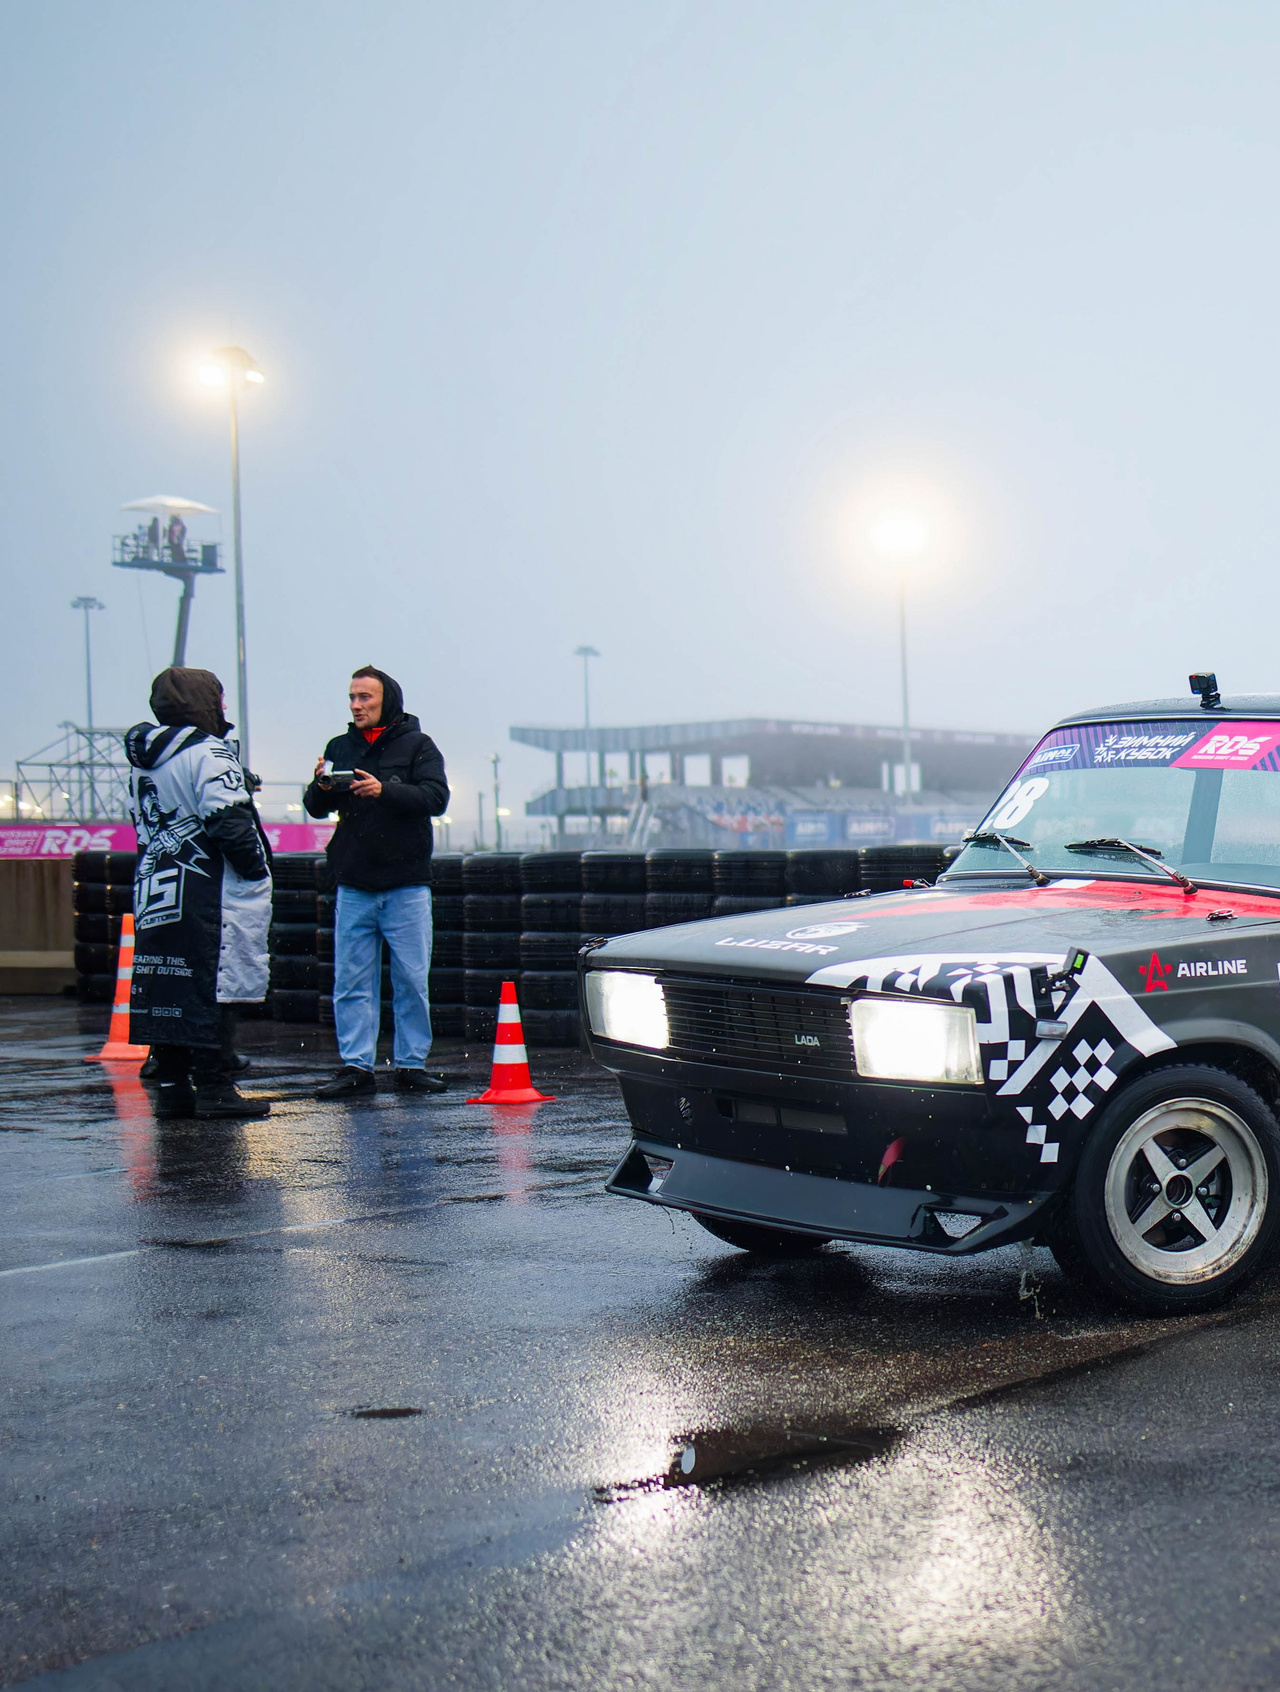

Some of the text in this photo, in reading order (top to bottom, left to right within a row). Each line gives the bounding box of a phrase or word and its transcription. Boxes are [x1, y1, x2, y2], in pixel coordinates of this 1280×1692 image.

[1112, 732, 1196, 748] ЗИМНИЙ
[1198, 735, 1272, 755] RDS
[1115, 748, 1181, 759] КУБОК
[41, 829, 117, 854] RDS
[715, 937, 839, 955] LUZAR
[134, 954, 164, 965] EADING
[1177, 959, 1247, 978] AIRLINE
[795, 1034, 820, 1046] LADA
